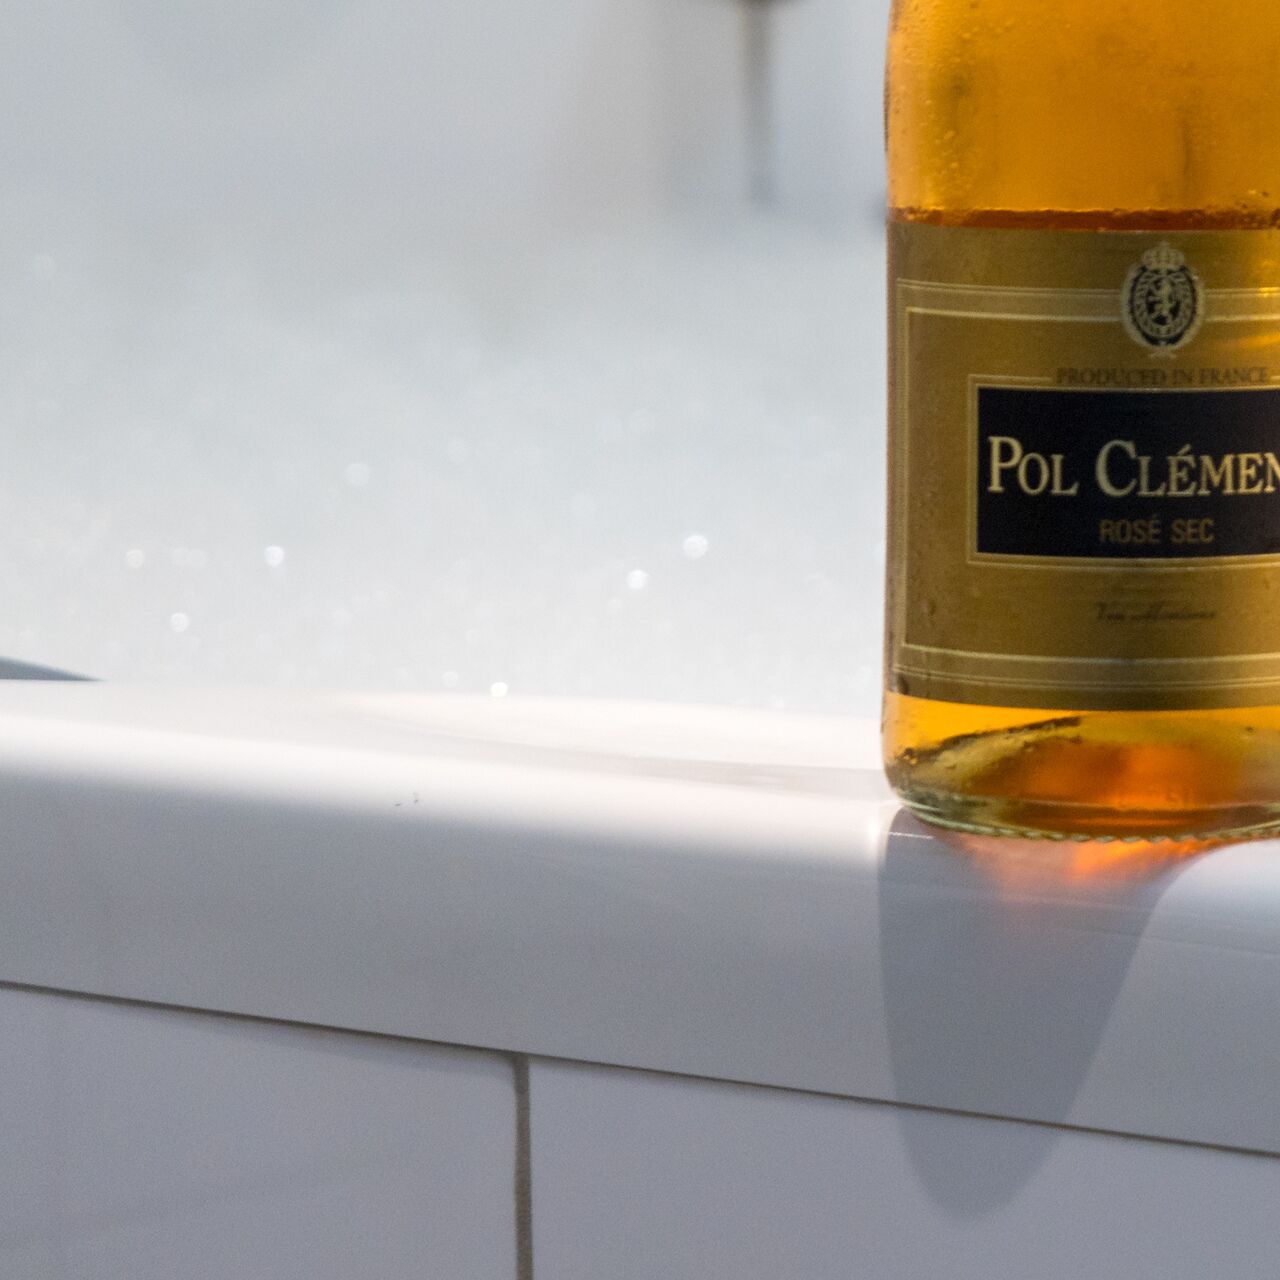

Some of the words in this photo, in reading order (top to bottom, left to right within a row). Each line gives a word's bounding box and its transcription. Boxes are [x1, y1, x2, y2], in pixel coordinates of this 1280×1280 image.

[1056, 367, 1167, 387] PRODUCED
[1172, 368, 1194, 385] IN
[1199, 366, 1270, 385] FRANCE
[987, 435, 1079, 497] POL
[1099, 514, 1161, 544] ROSÉ
[1170, 517, 1215, 544] SEC
